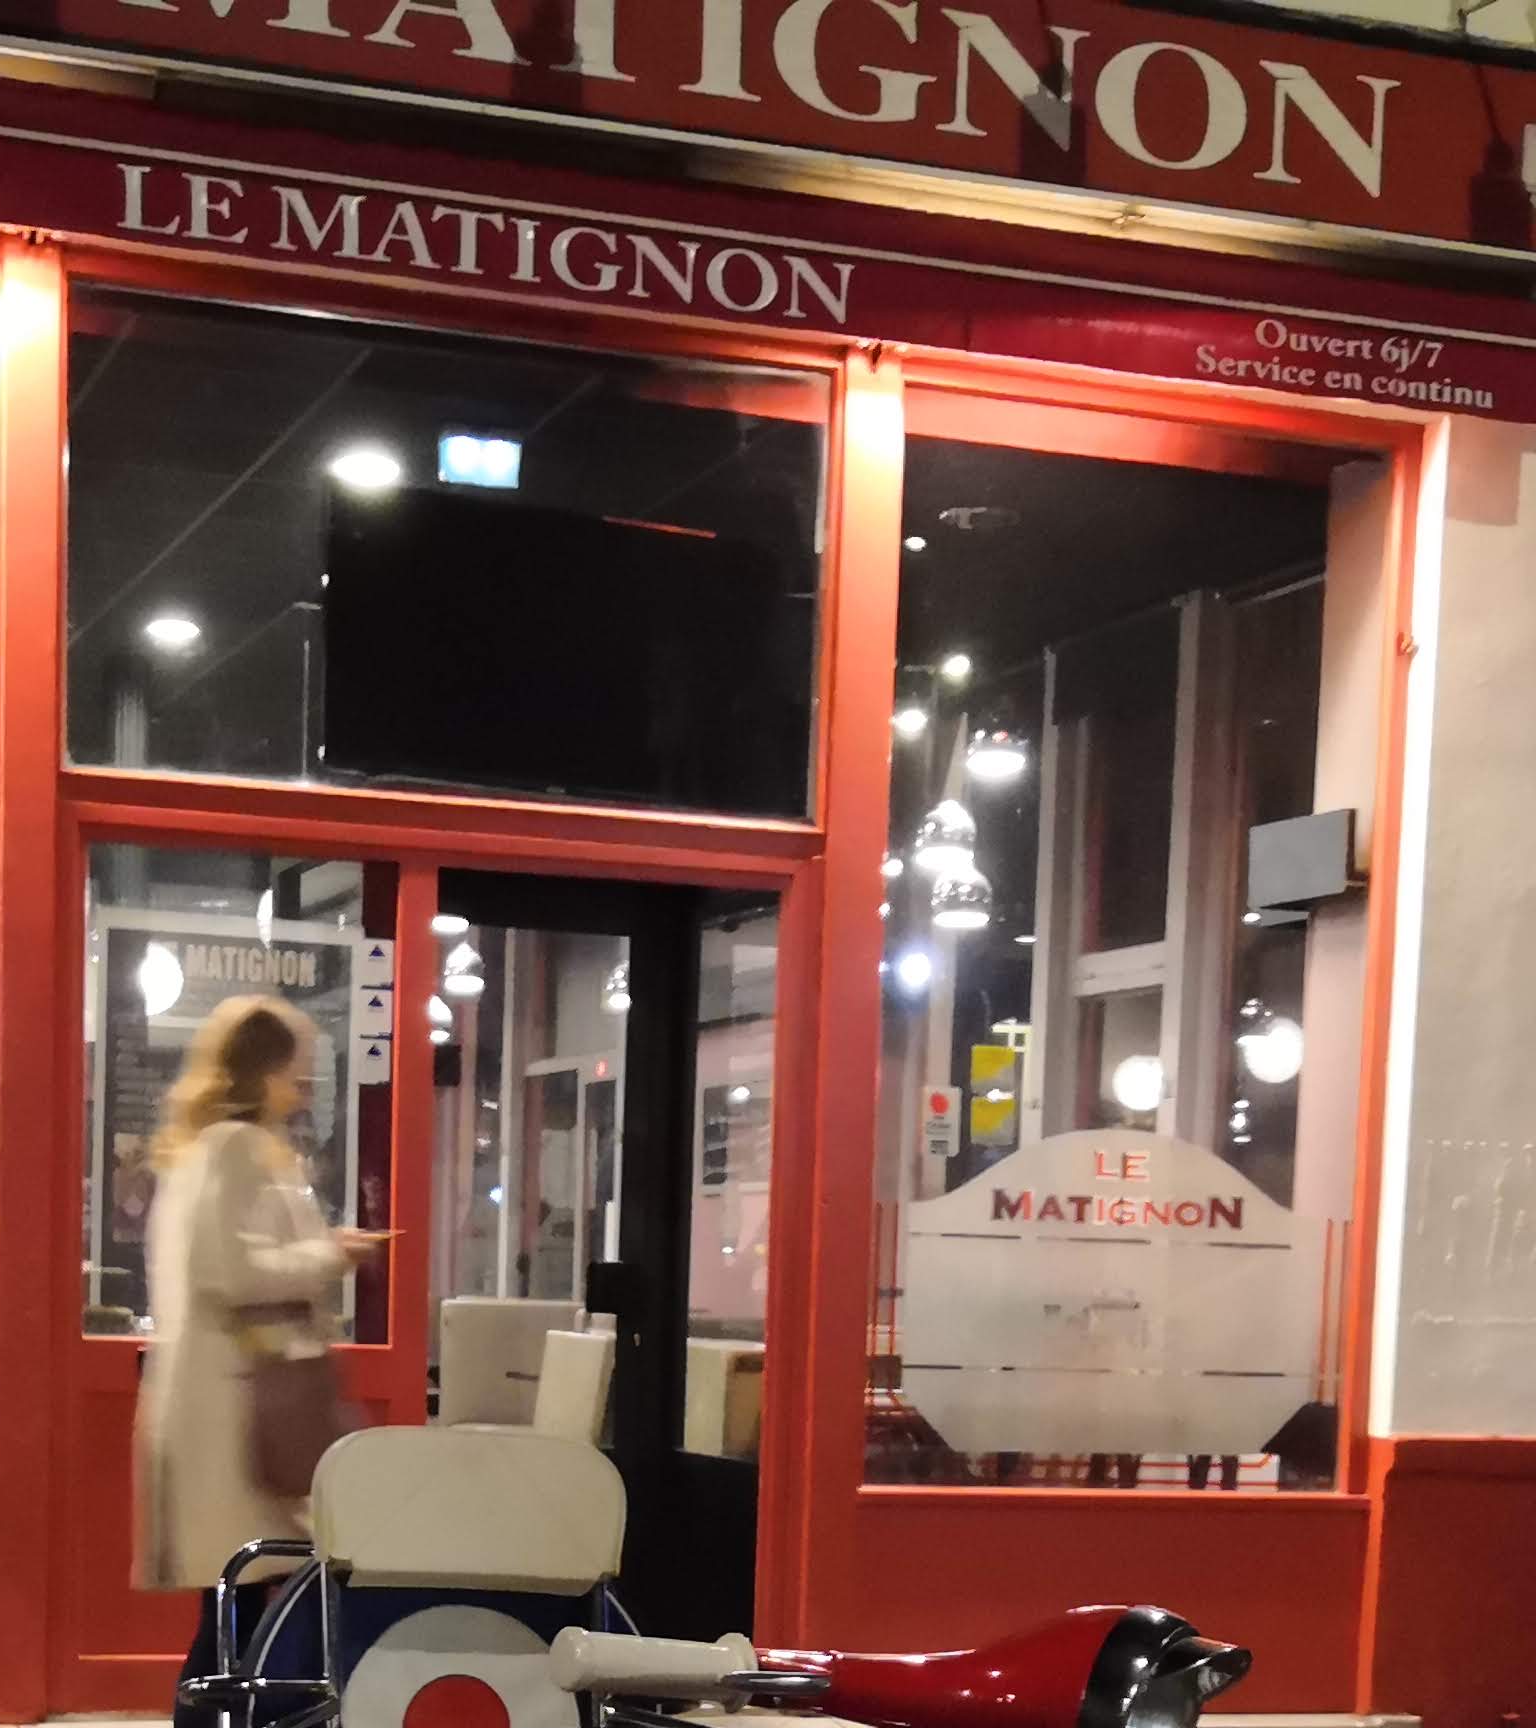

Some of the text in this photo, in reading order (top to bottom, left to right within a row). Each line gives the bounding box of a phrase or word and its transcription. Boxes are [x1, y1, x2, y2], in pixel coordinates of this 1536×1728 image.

[119, 0, 1401, 198] TIGNON
[115, 163, 856, 325] LE MATIGNON
[1254, 319, 1444, 374] Ouvert 6j/7
[1196, 343, 1495, 410] Service en continu
[184, 944, 317, 988] MATIGNON
[1094, 1151, 1151, 1181] LE
[991, 1189, 1244, 1230] MATIGNON
